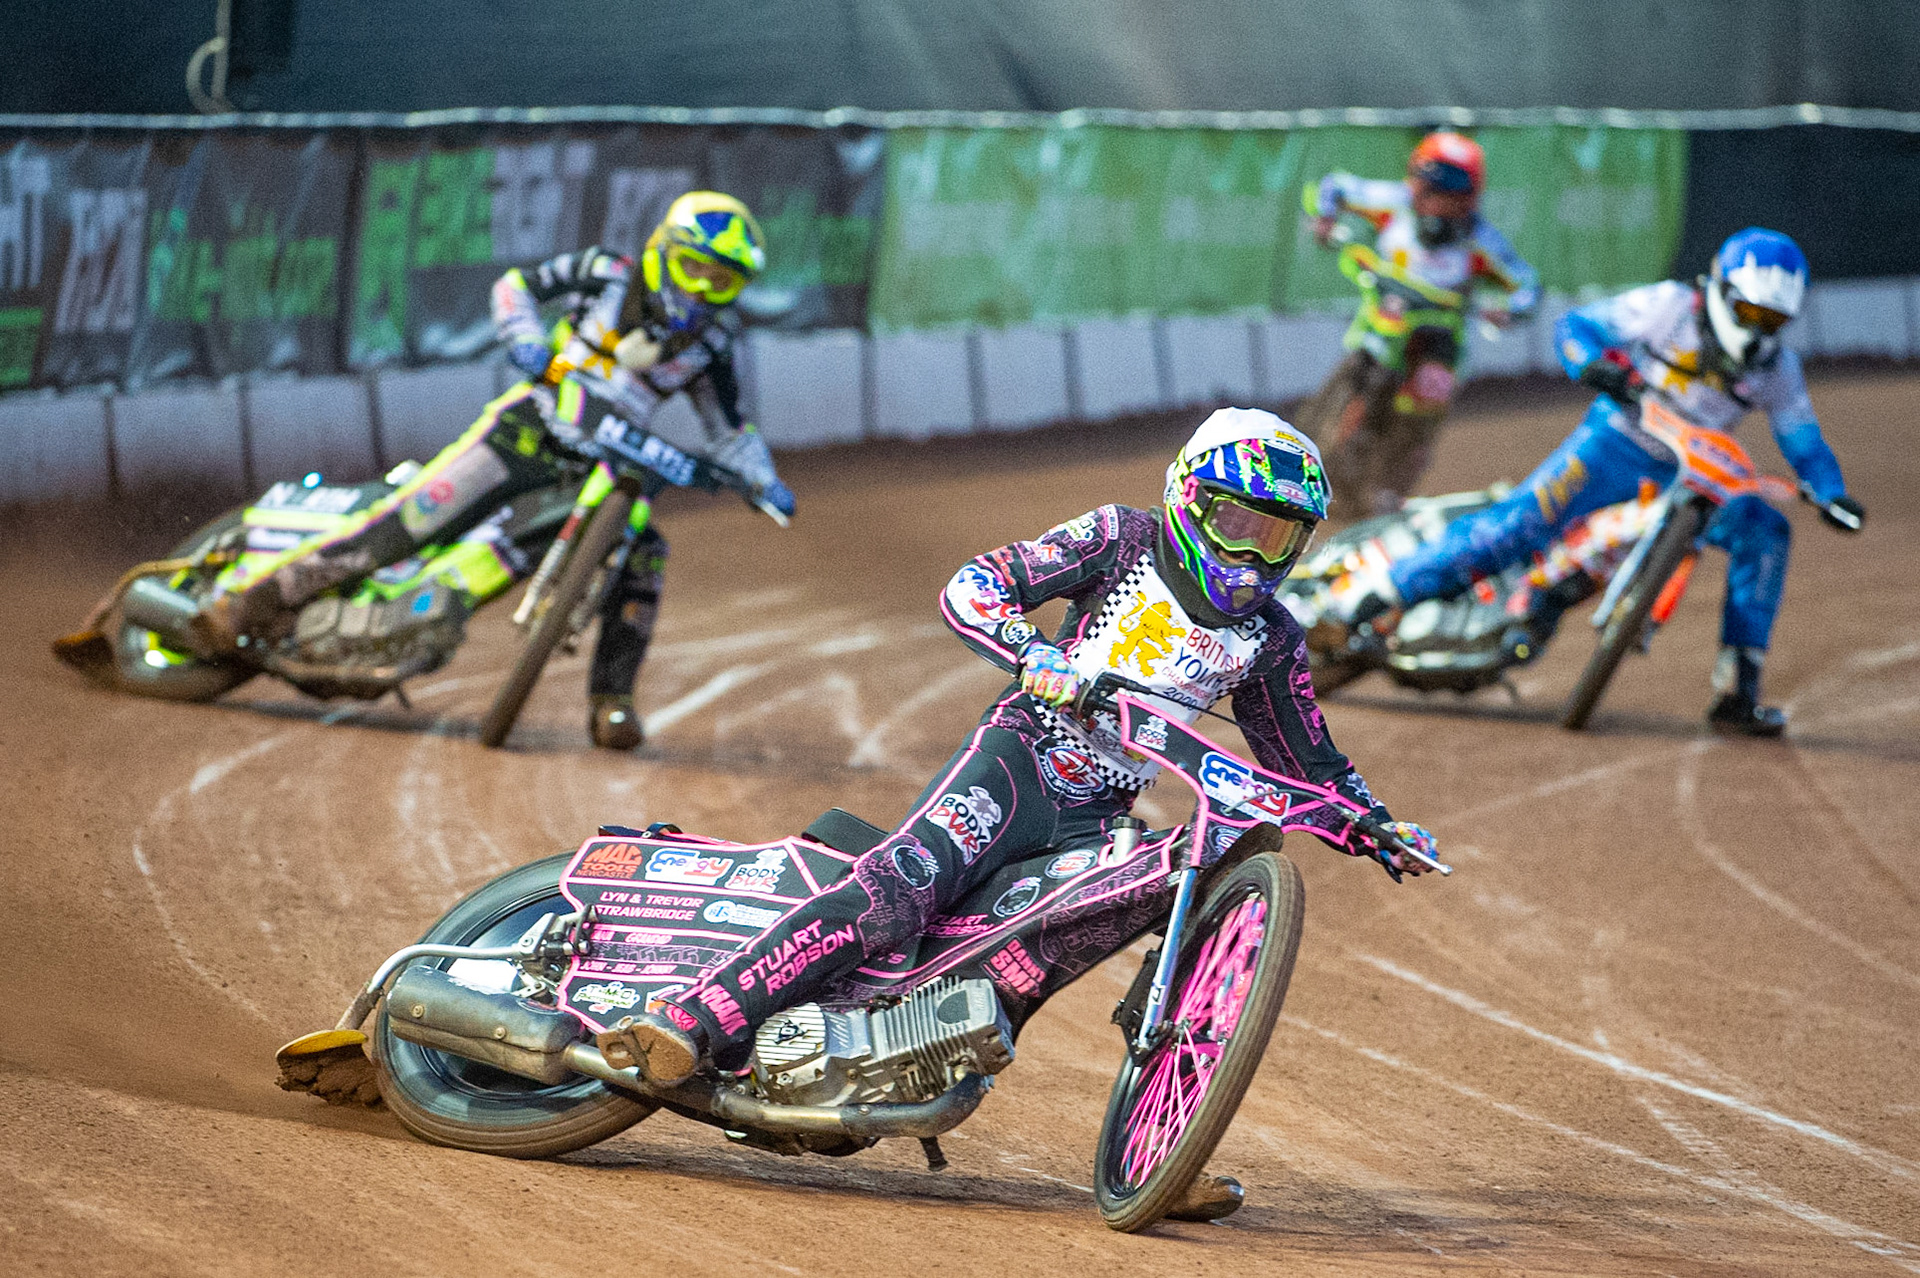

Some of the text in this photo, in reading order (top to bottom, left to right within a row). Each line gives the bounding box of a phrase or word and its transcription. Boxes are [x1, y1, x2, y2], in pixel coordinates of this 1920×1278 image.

[944, 797, 987, 841] BODY
[584, 843, 643, 865] MAC
[581, 862, 638, 873] TOOLS
[736, 867, 781, 878] BODY
[600, 891, 705, 908] LYN & TREVOR
[738, 919, 823, 991] STUART
[764, 924, 856, 996] ROBSON
